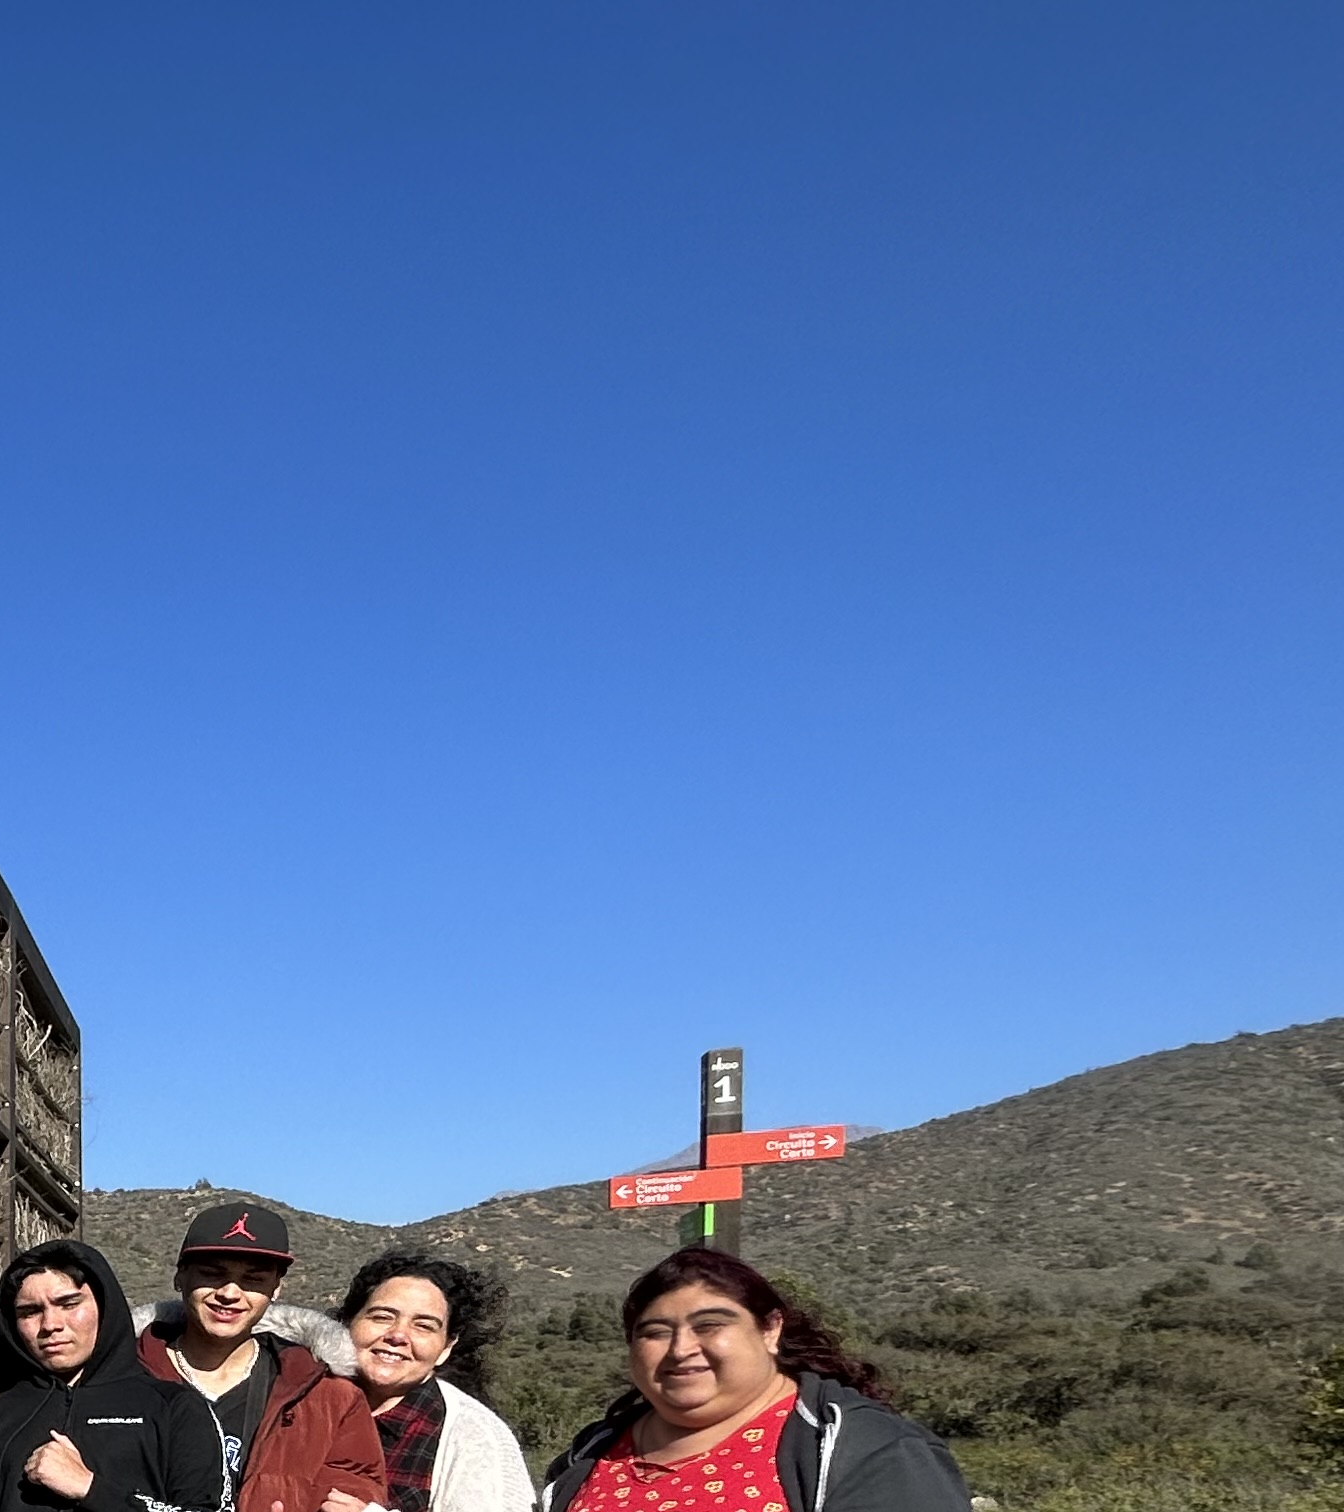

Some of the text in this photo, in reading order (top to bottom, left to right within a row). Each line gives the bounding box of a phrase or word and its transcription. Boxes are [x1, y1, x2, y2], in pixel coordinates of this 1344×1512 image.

[713, 1075, 737, 1103] 1
[765, 1139, 816, 1151] Circuito
[779, 1148, 815, 1159] Corto
[635, 1183, 683, 1194] Circuito
[636, 1193, 670, 1204] Corto
